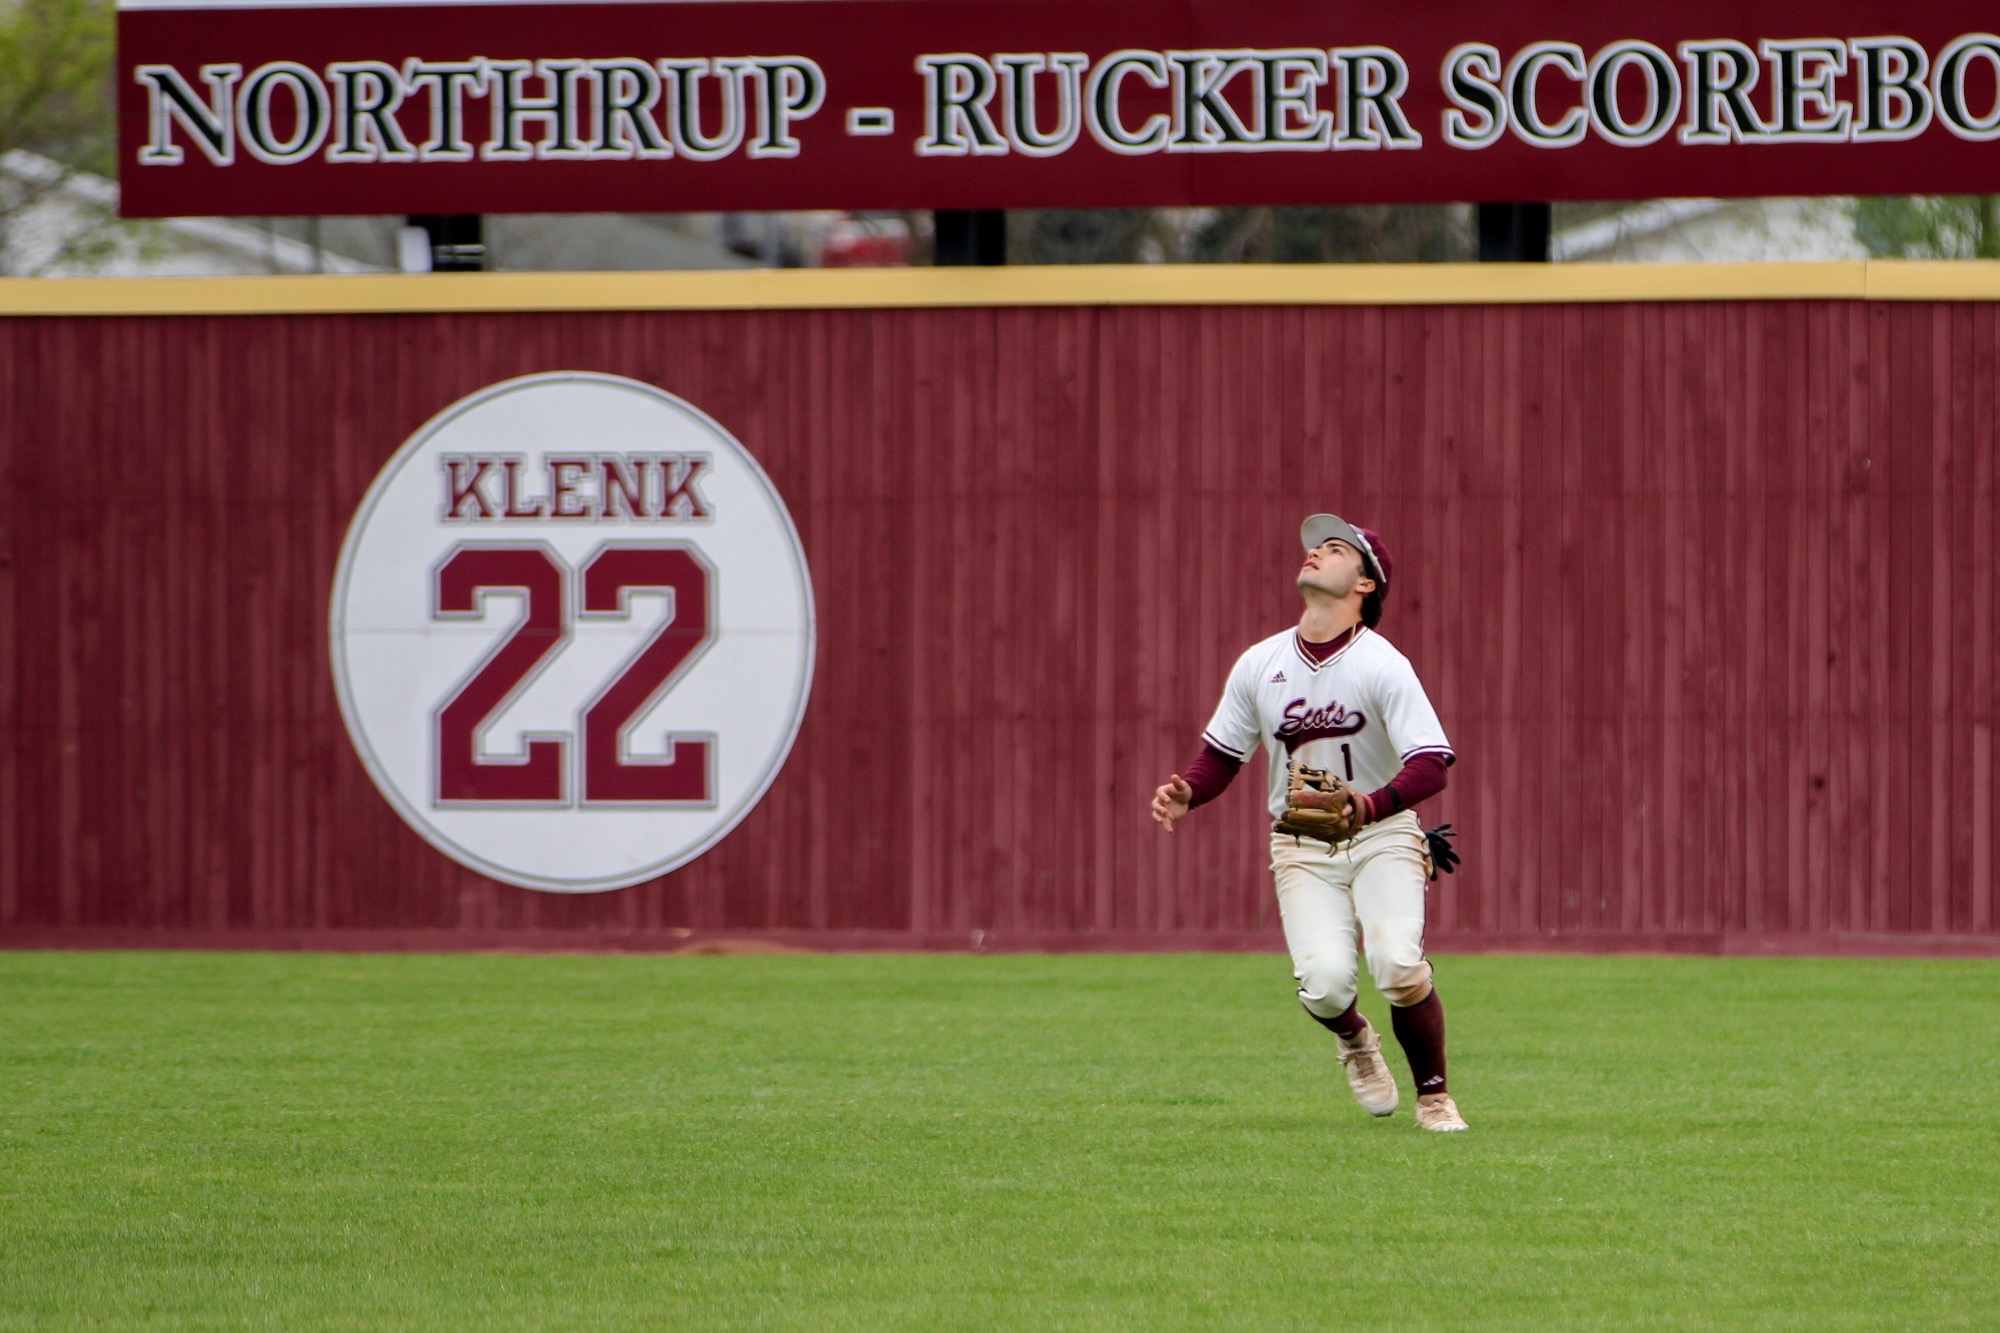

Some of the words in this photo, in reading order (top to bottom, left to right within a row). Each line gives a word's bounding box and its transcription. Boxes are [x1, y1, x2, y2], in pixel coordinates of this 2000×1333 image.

[136, 56, 826, 165] NORTHRUP
[847, 108, 895, 136] -
[916, 48, 1422, 156] RUCKER
[1443, 33, 2000, 149] SCOREBO
[439, 451, 716, 525] KLENK
[431, 539, 719, 811] 22
[1277, 698, 1365, 741] Scots
[1341, 743, 1354, 781] 1
